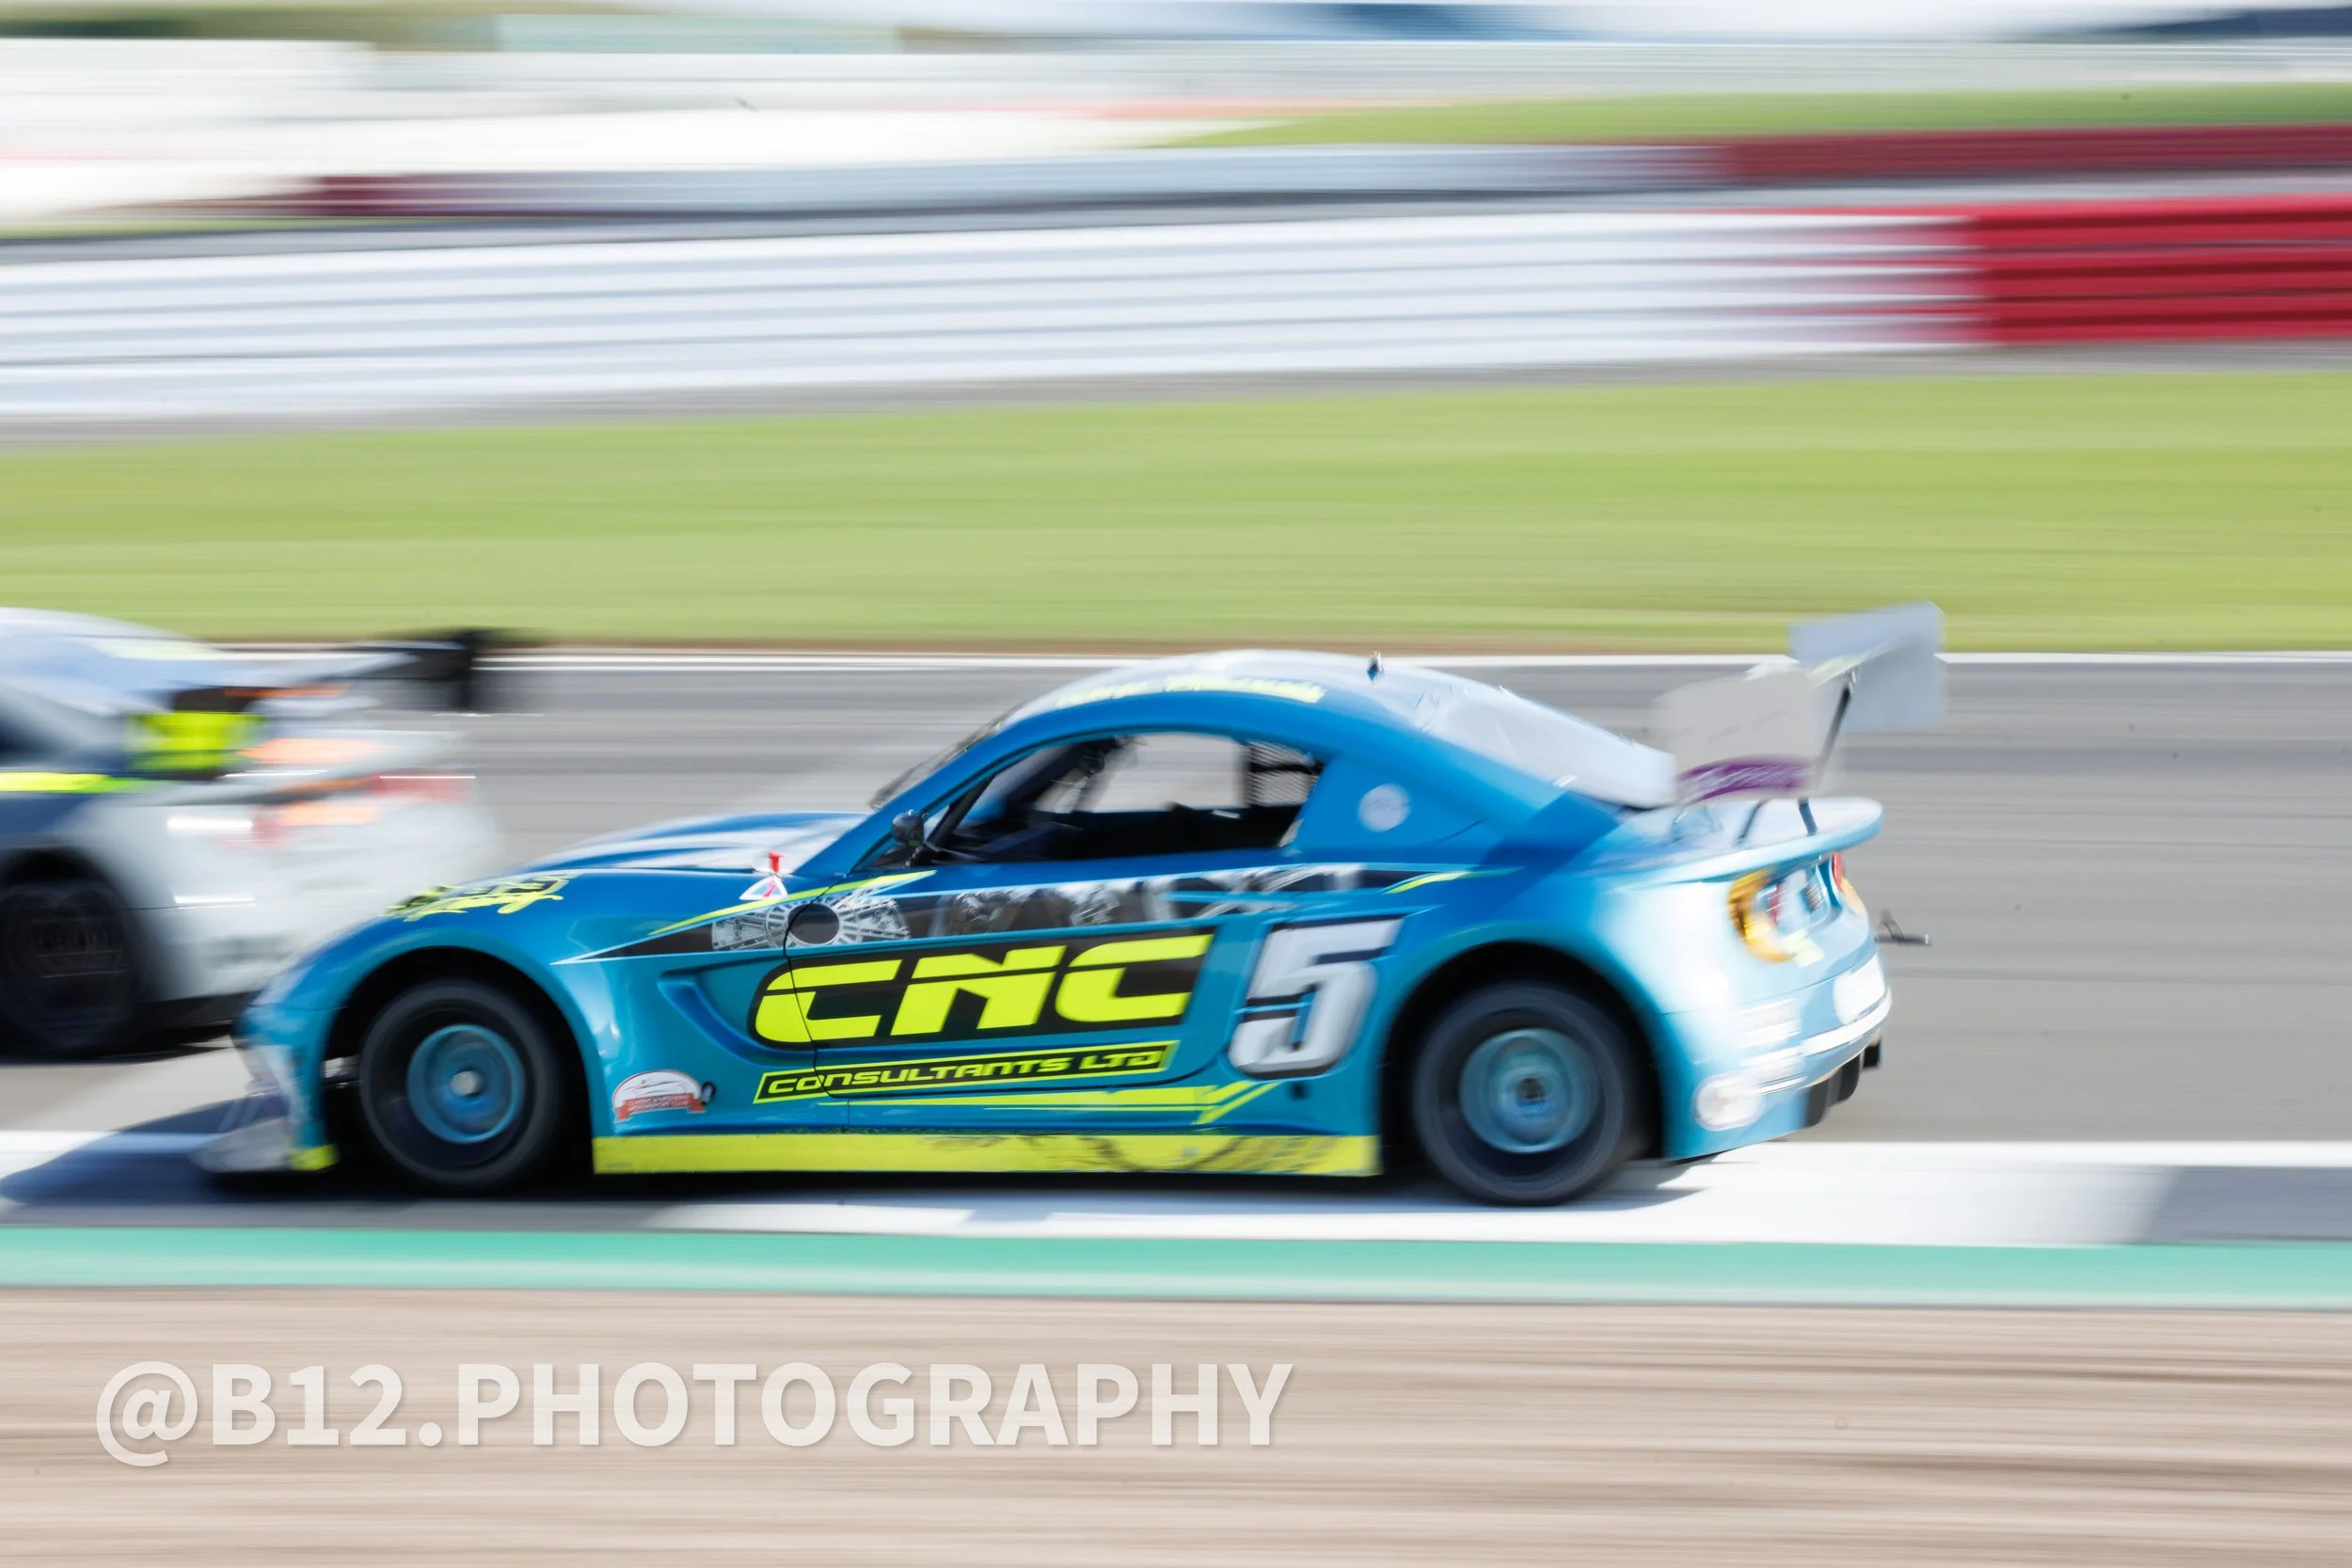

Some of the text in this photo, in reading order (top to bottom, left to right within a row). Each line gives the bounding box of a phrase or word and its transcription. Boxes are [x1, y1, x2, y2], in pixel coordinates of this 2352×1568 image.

[755, 934, 1214, 1042] CNC
[1228, 917, 1405, 1076] 5
[767, 1050, 1165, 1094] CONSULTANTS LTD
